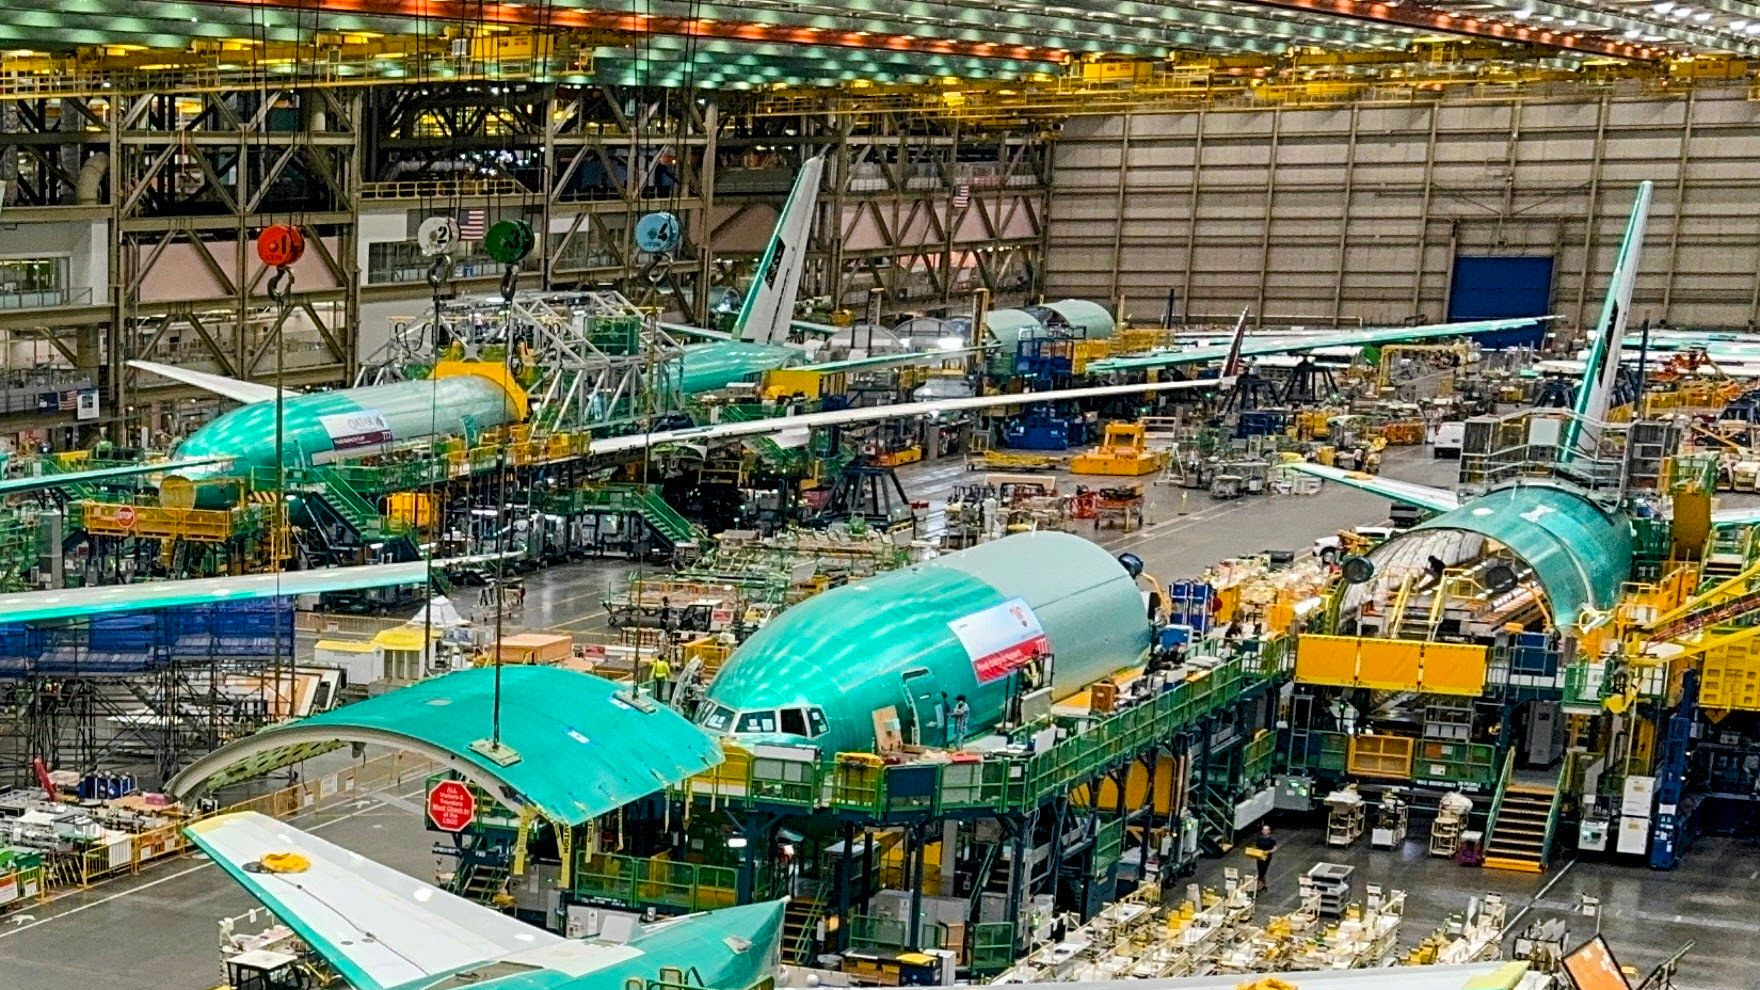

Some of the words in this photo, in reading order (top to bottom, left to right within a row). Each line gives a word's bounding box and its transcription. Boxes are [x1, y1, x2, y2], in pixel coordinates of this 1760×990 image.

[437, 225, 448, 244] 2
[657, 222, 669, 242] 4
[281, 233, 287, 255] 1
